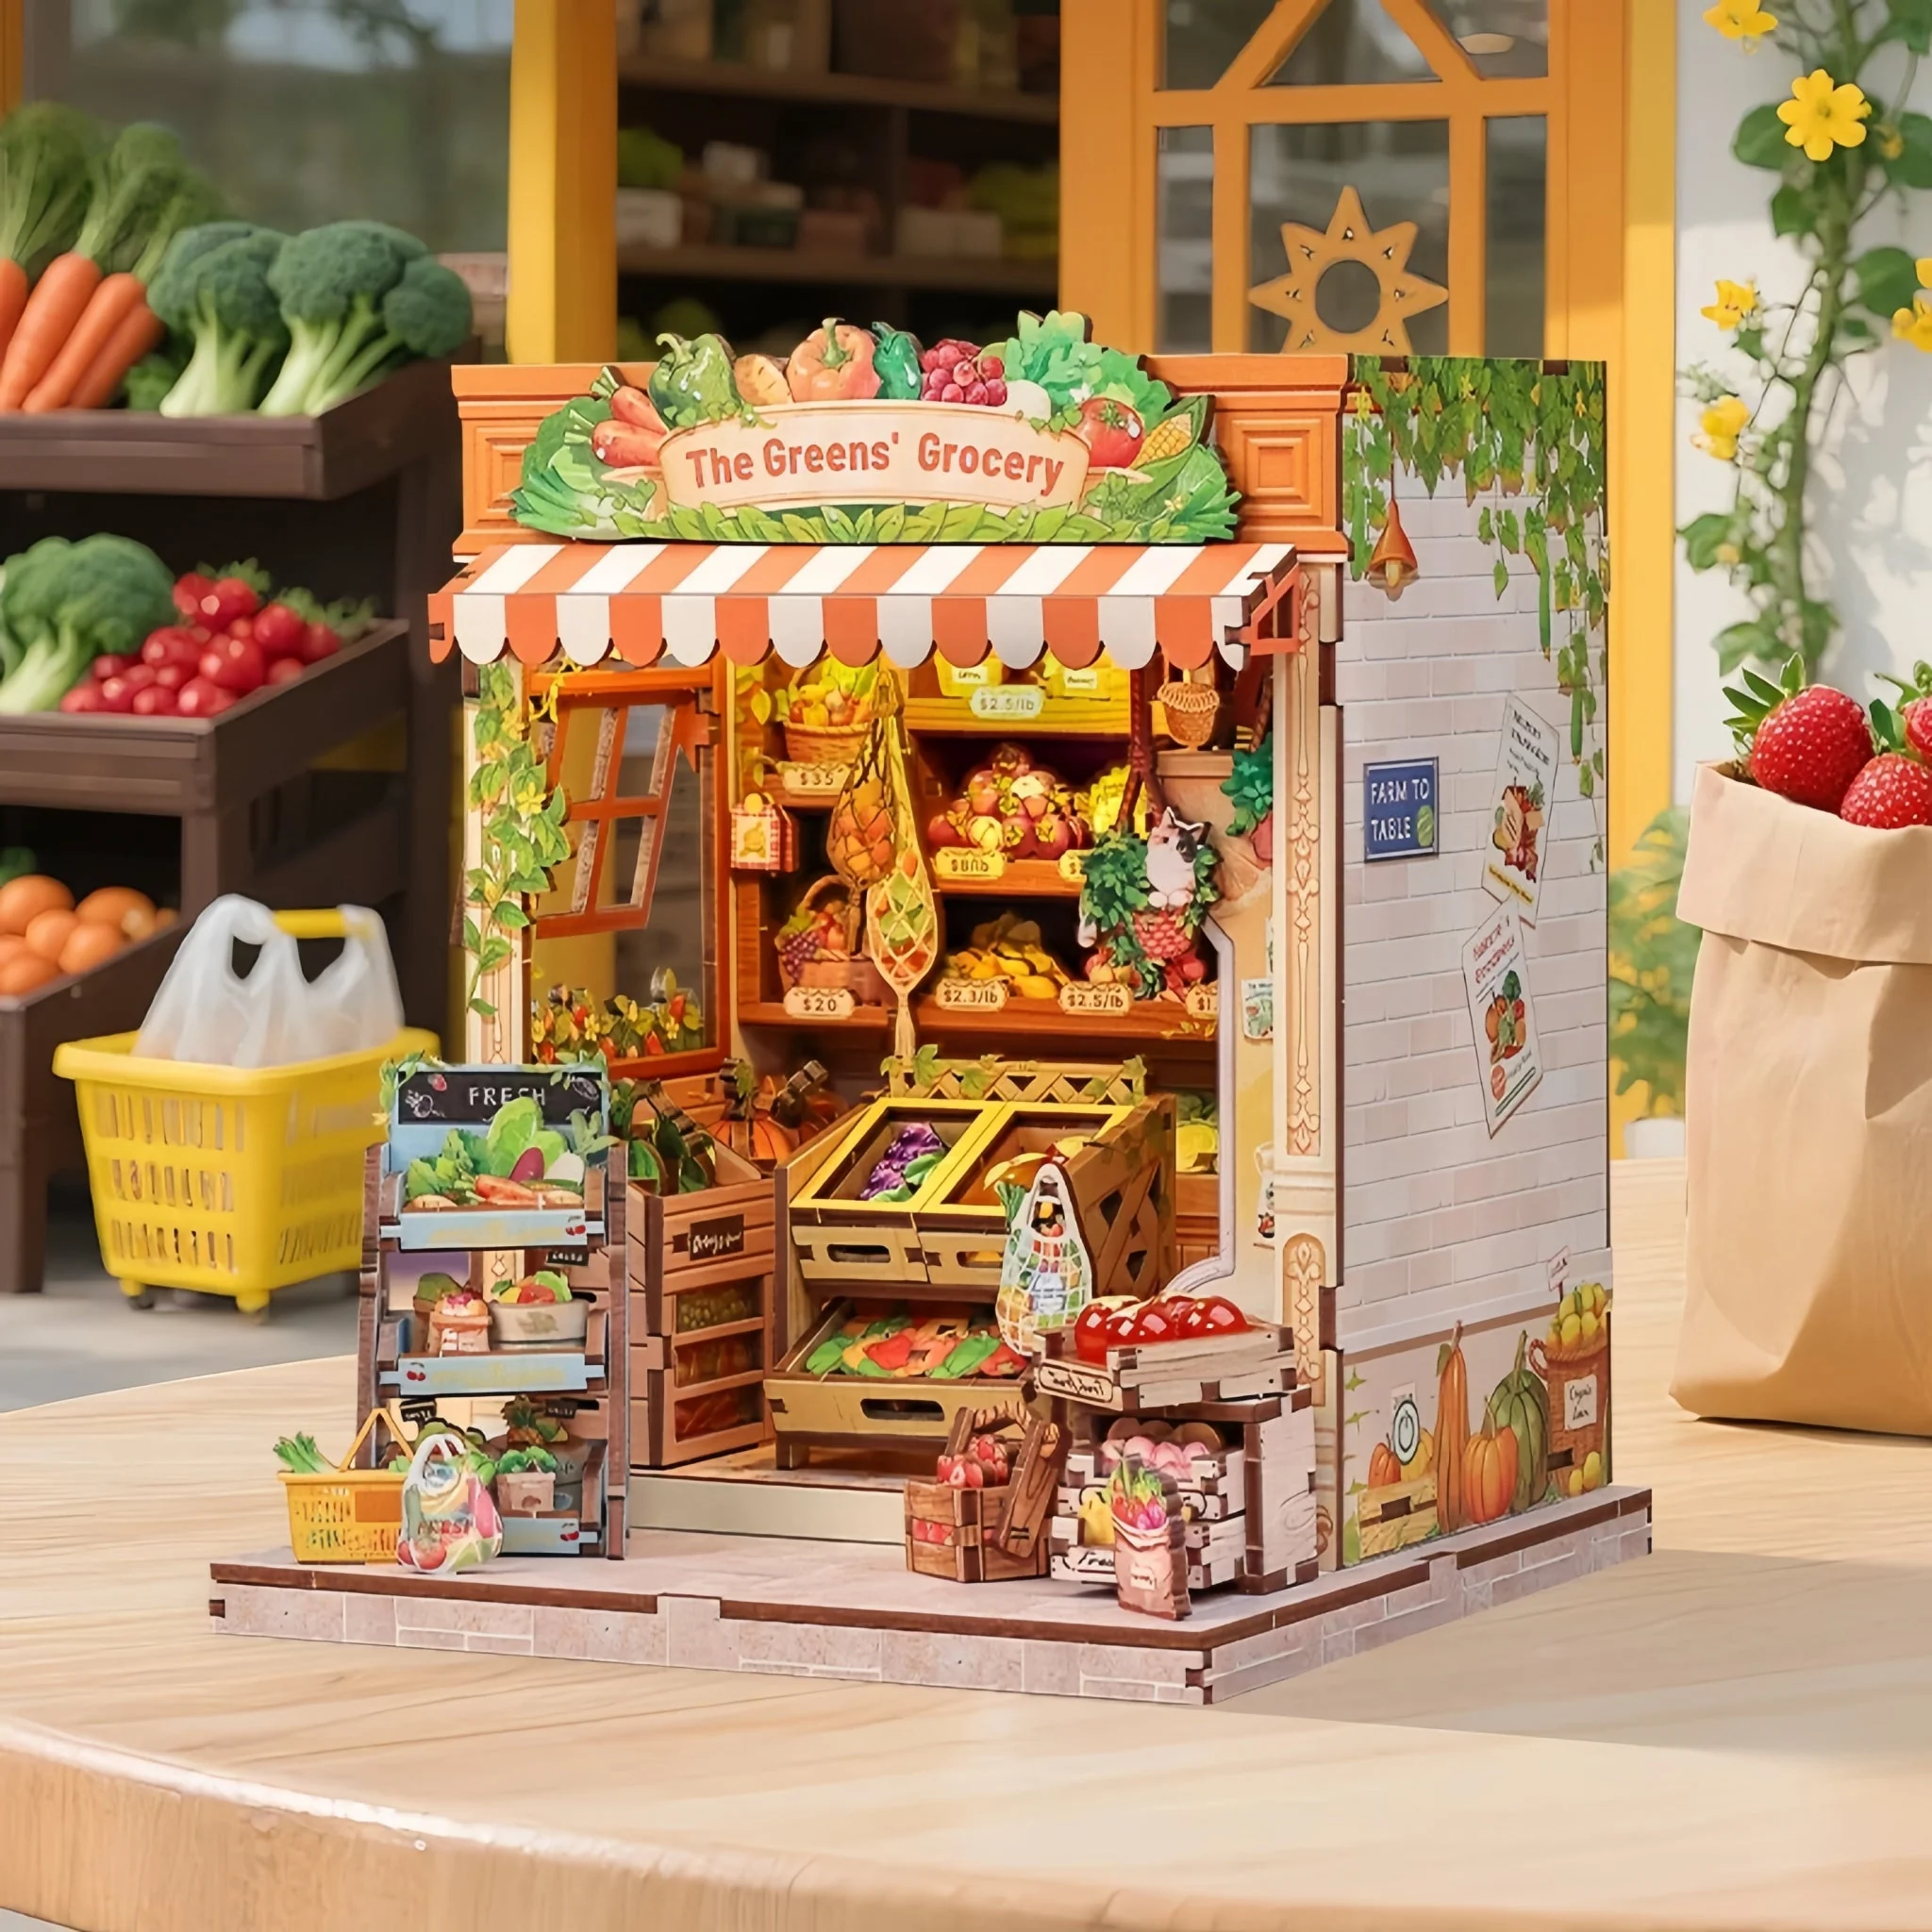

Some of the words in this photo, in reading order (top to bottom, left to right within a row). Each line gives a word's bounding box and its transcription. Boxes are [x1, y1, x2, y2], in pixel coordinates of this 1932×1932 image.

[686, 447, 754, 489] The
[762, 431, 899, 477] Greens'
[917, 432, 1064, 497] Grocery
[799, 772, 834, 786] $35
[1411, 777, 1430, 800] TO
[1371, 816, 1411, 841] TABLE
[803, 997, 837, 1012] $20
[1067, 993, 1124, 1009] $2.5/lb
